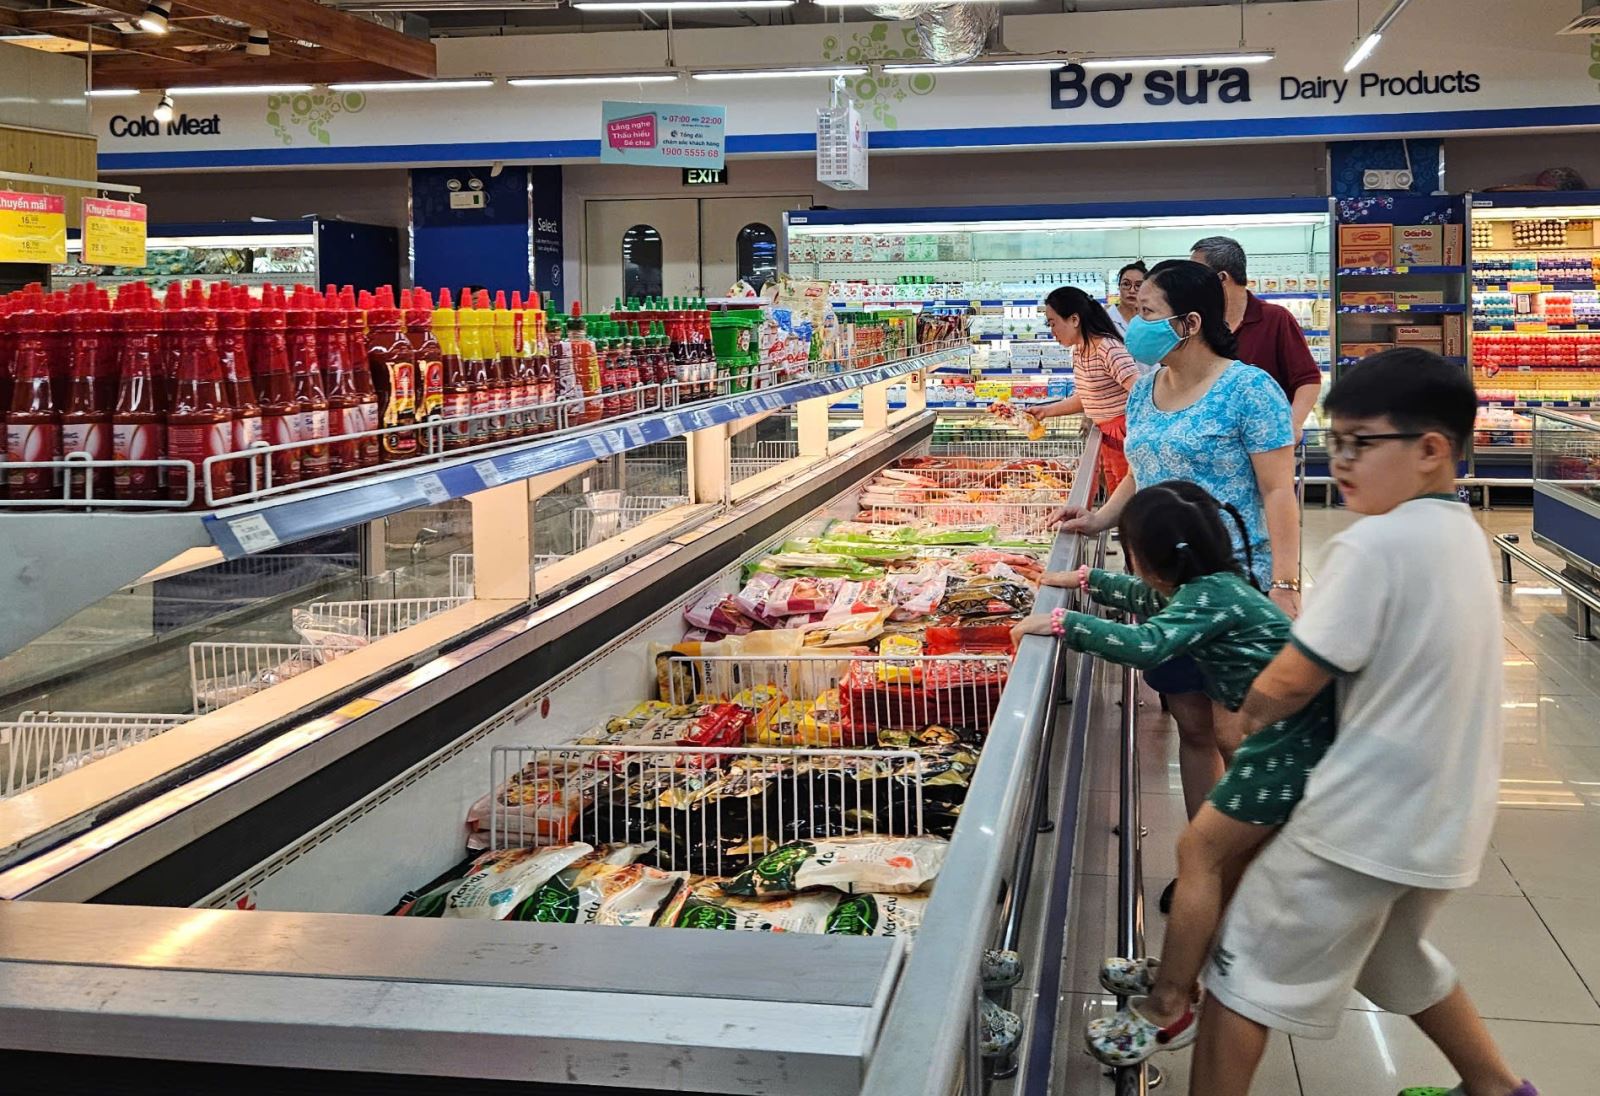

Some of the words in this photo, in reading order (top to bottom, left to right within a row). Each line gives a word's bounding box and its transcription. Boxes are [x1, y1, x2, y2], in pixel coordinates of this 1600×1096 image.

[1050, 64, 1132, 110] Bơ
[1143, 64, 1251, 106] sữa
[1279, 76, 1348, 104] Dairy
[1360, 68, 1480, 98] Products
[109, 113, 159, 137] Cold
[166, 113, 221, 136] Meat
[631, 120, 651, 130] nghe
[668, 115, 690, 123] 07:00
[700, 116, 722, 125] 22:00
[661, 147, 683, 156] 1900
[684, 148, 706, 157] 5555
[688, 169, 721, 184] EXIT
[86, 203, 116, 217] Khuyến
[537, 217, 558, 234] Select
[450, 873, 489, 909] Mandu
